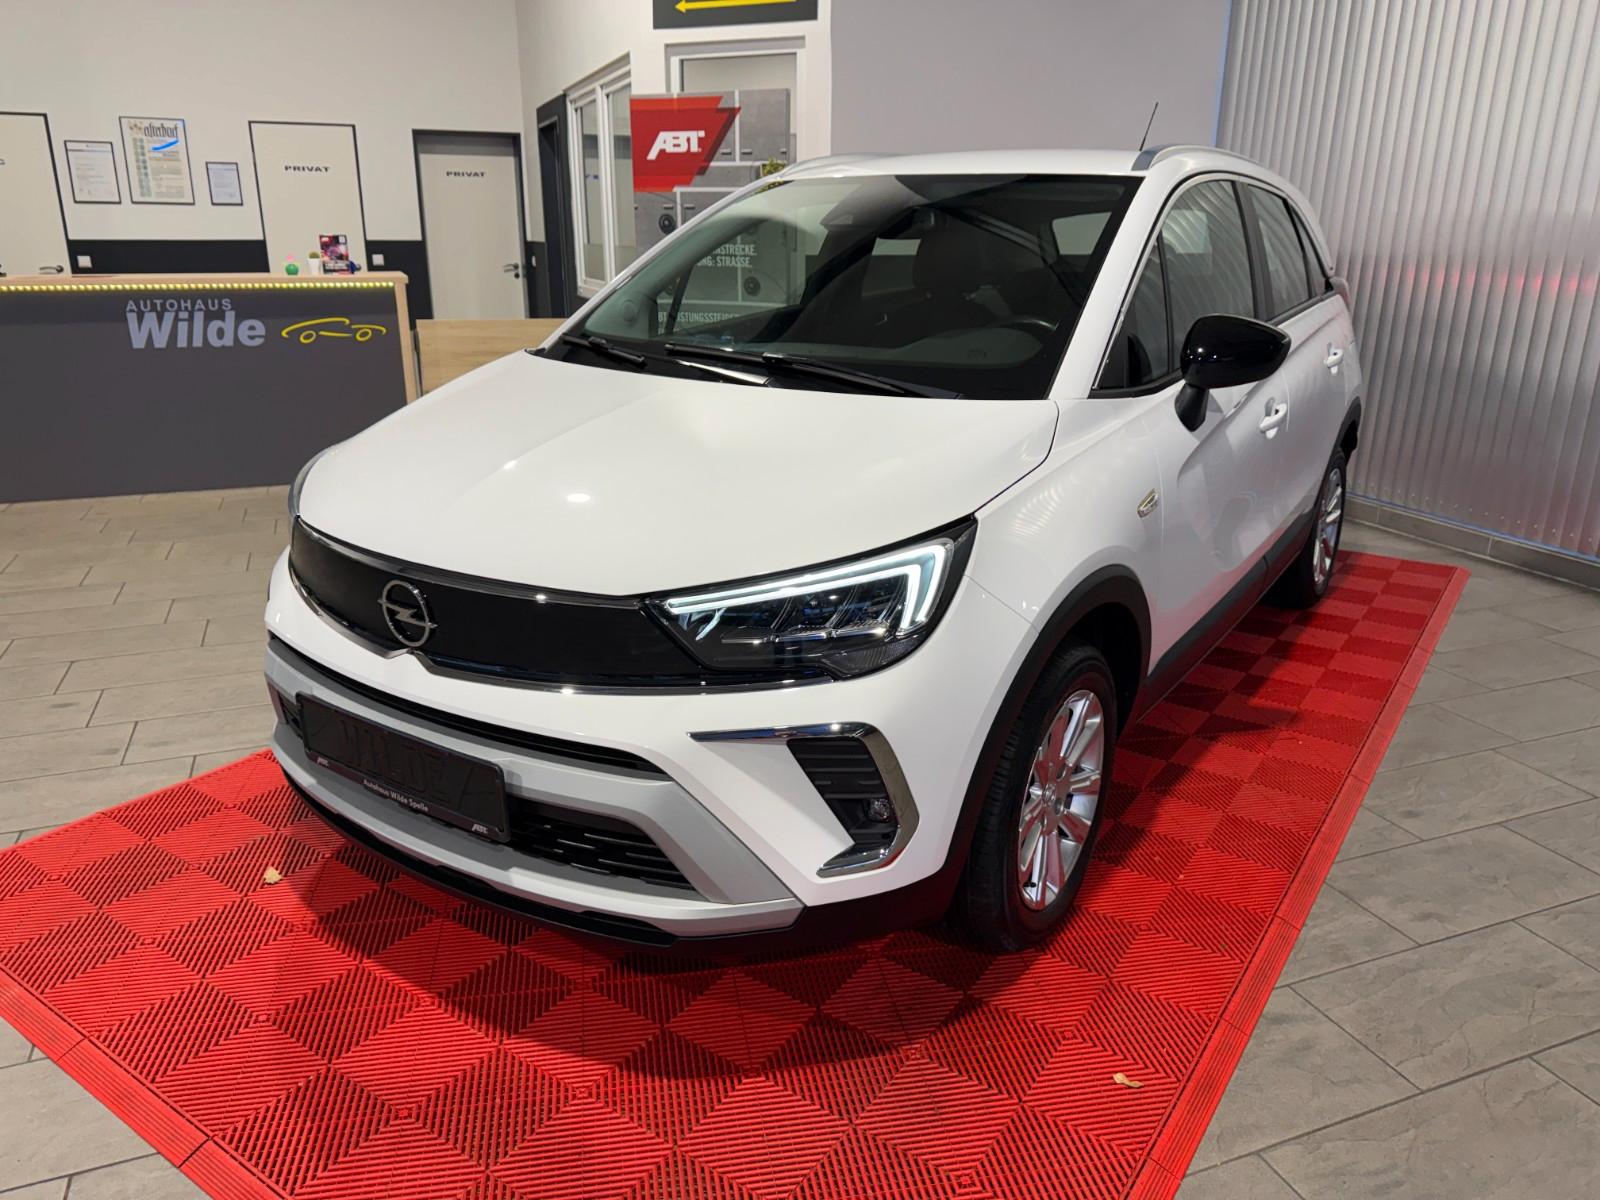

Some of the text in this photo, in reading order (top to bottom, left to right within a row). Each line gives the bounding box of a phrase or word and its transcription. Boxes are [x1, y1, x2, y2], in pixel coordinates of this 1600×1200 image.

[646, 130, 705, 160] ABT
[284, 165, 331, 173] PRIVAT
[126, 298, 232, 312] AUTOHAUS
[126, 310, 266, 349] Wilde
